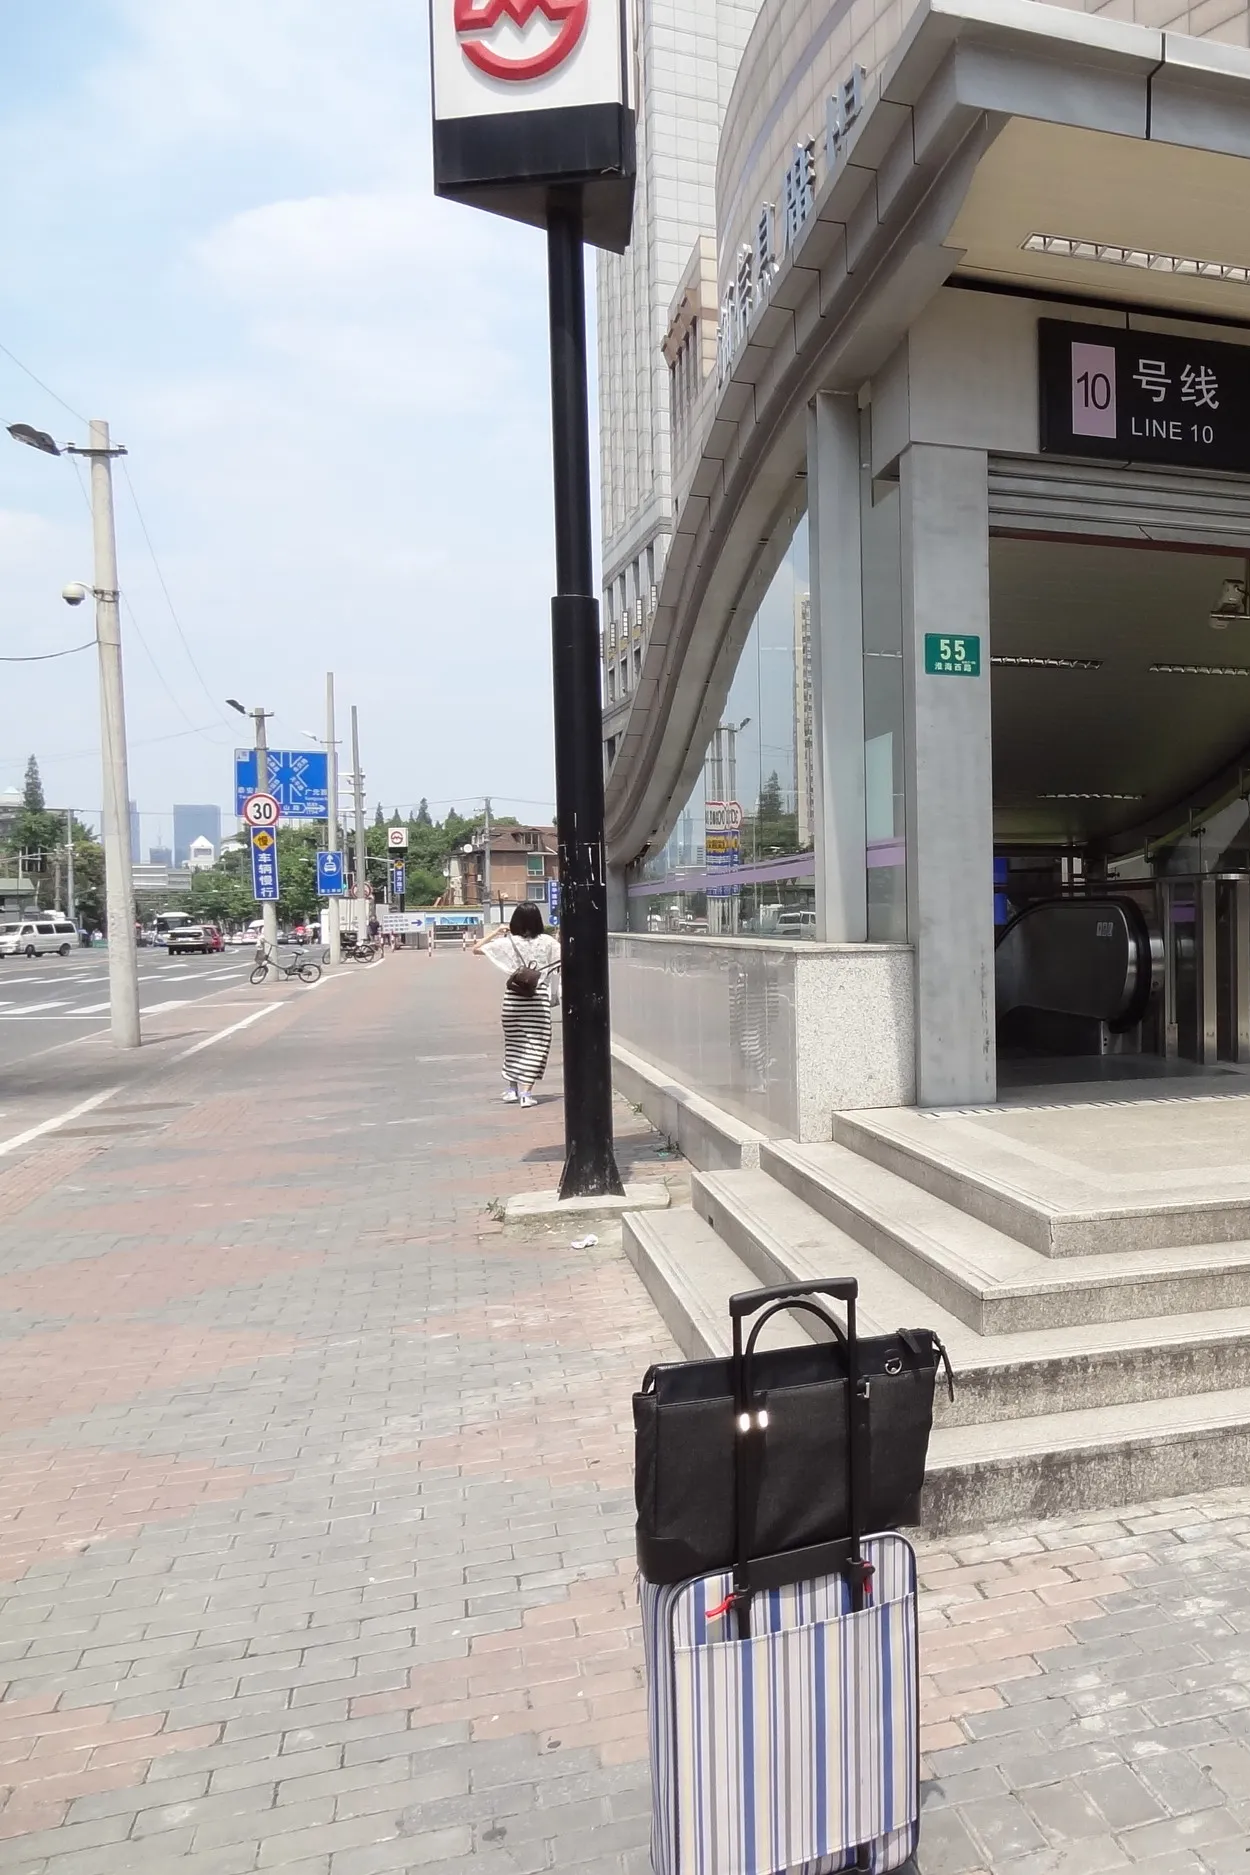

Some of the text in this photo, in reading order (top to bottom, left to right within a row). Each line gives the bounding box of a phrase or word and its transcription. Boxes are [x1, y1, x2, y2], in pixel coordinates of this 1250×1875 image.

[1076, 371, 1111, 410] 10
[1132, 358, 1220, 410] 号线
[1131, 416, 1214, 444] LINE 10
[940, 639, 966, 661] 55
[252, 803, 272, 820] 30
[258, 853, 274, 898] 车辆慢行
